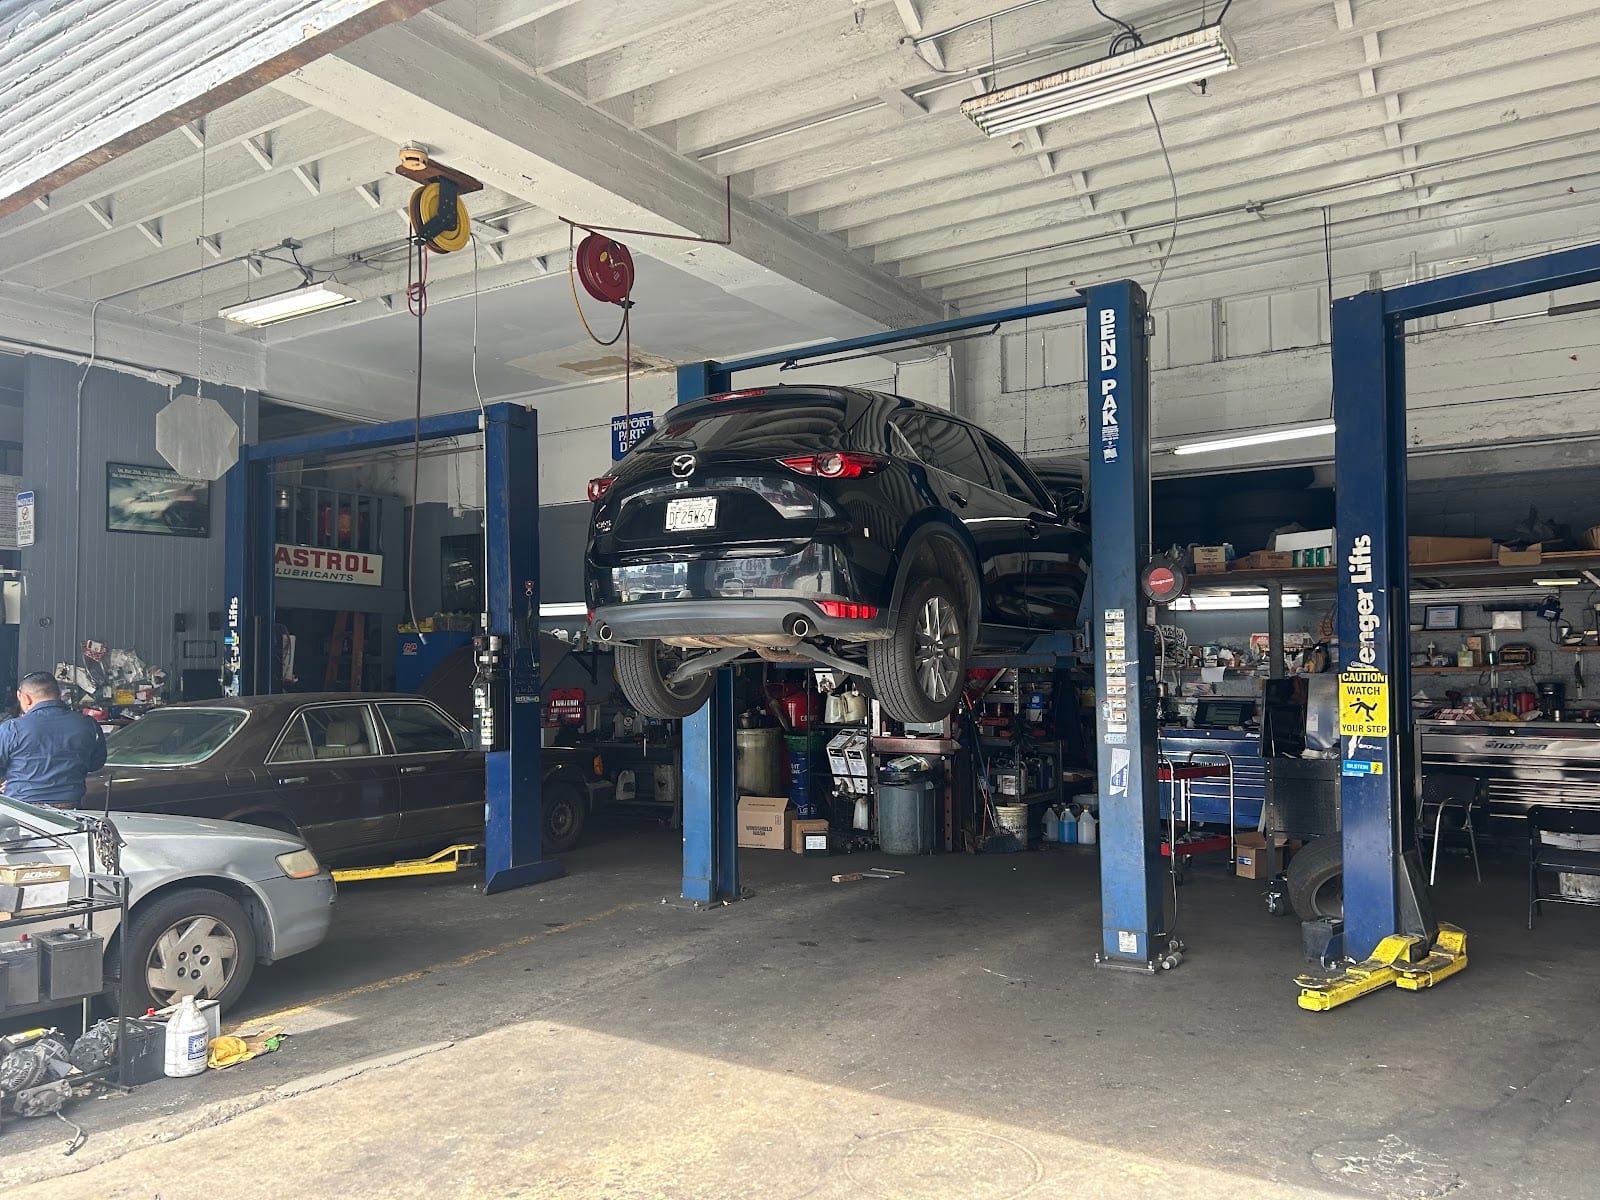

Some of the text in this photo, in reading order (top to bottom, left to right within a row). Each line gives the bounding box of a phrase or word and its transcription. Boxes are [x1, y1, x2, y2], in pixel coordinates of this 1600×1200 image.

[1100, 309, 1117, 371] BEND
[1101, 379, 1118, 426] PAK
[1348, 535, 1372, 583] Lifts
[275, 567, 354, 582] LUBRICANTS
[1342, 672, 1385, 683] CAUTION
[1347, 686, 1380, 695] WATCH
[1342, 724, 1387, 734] YOUR STEP
